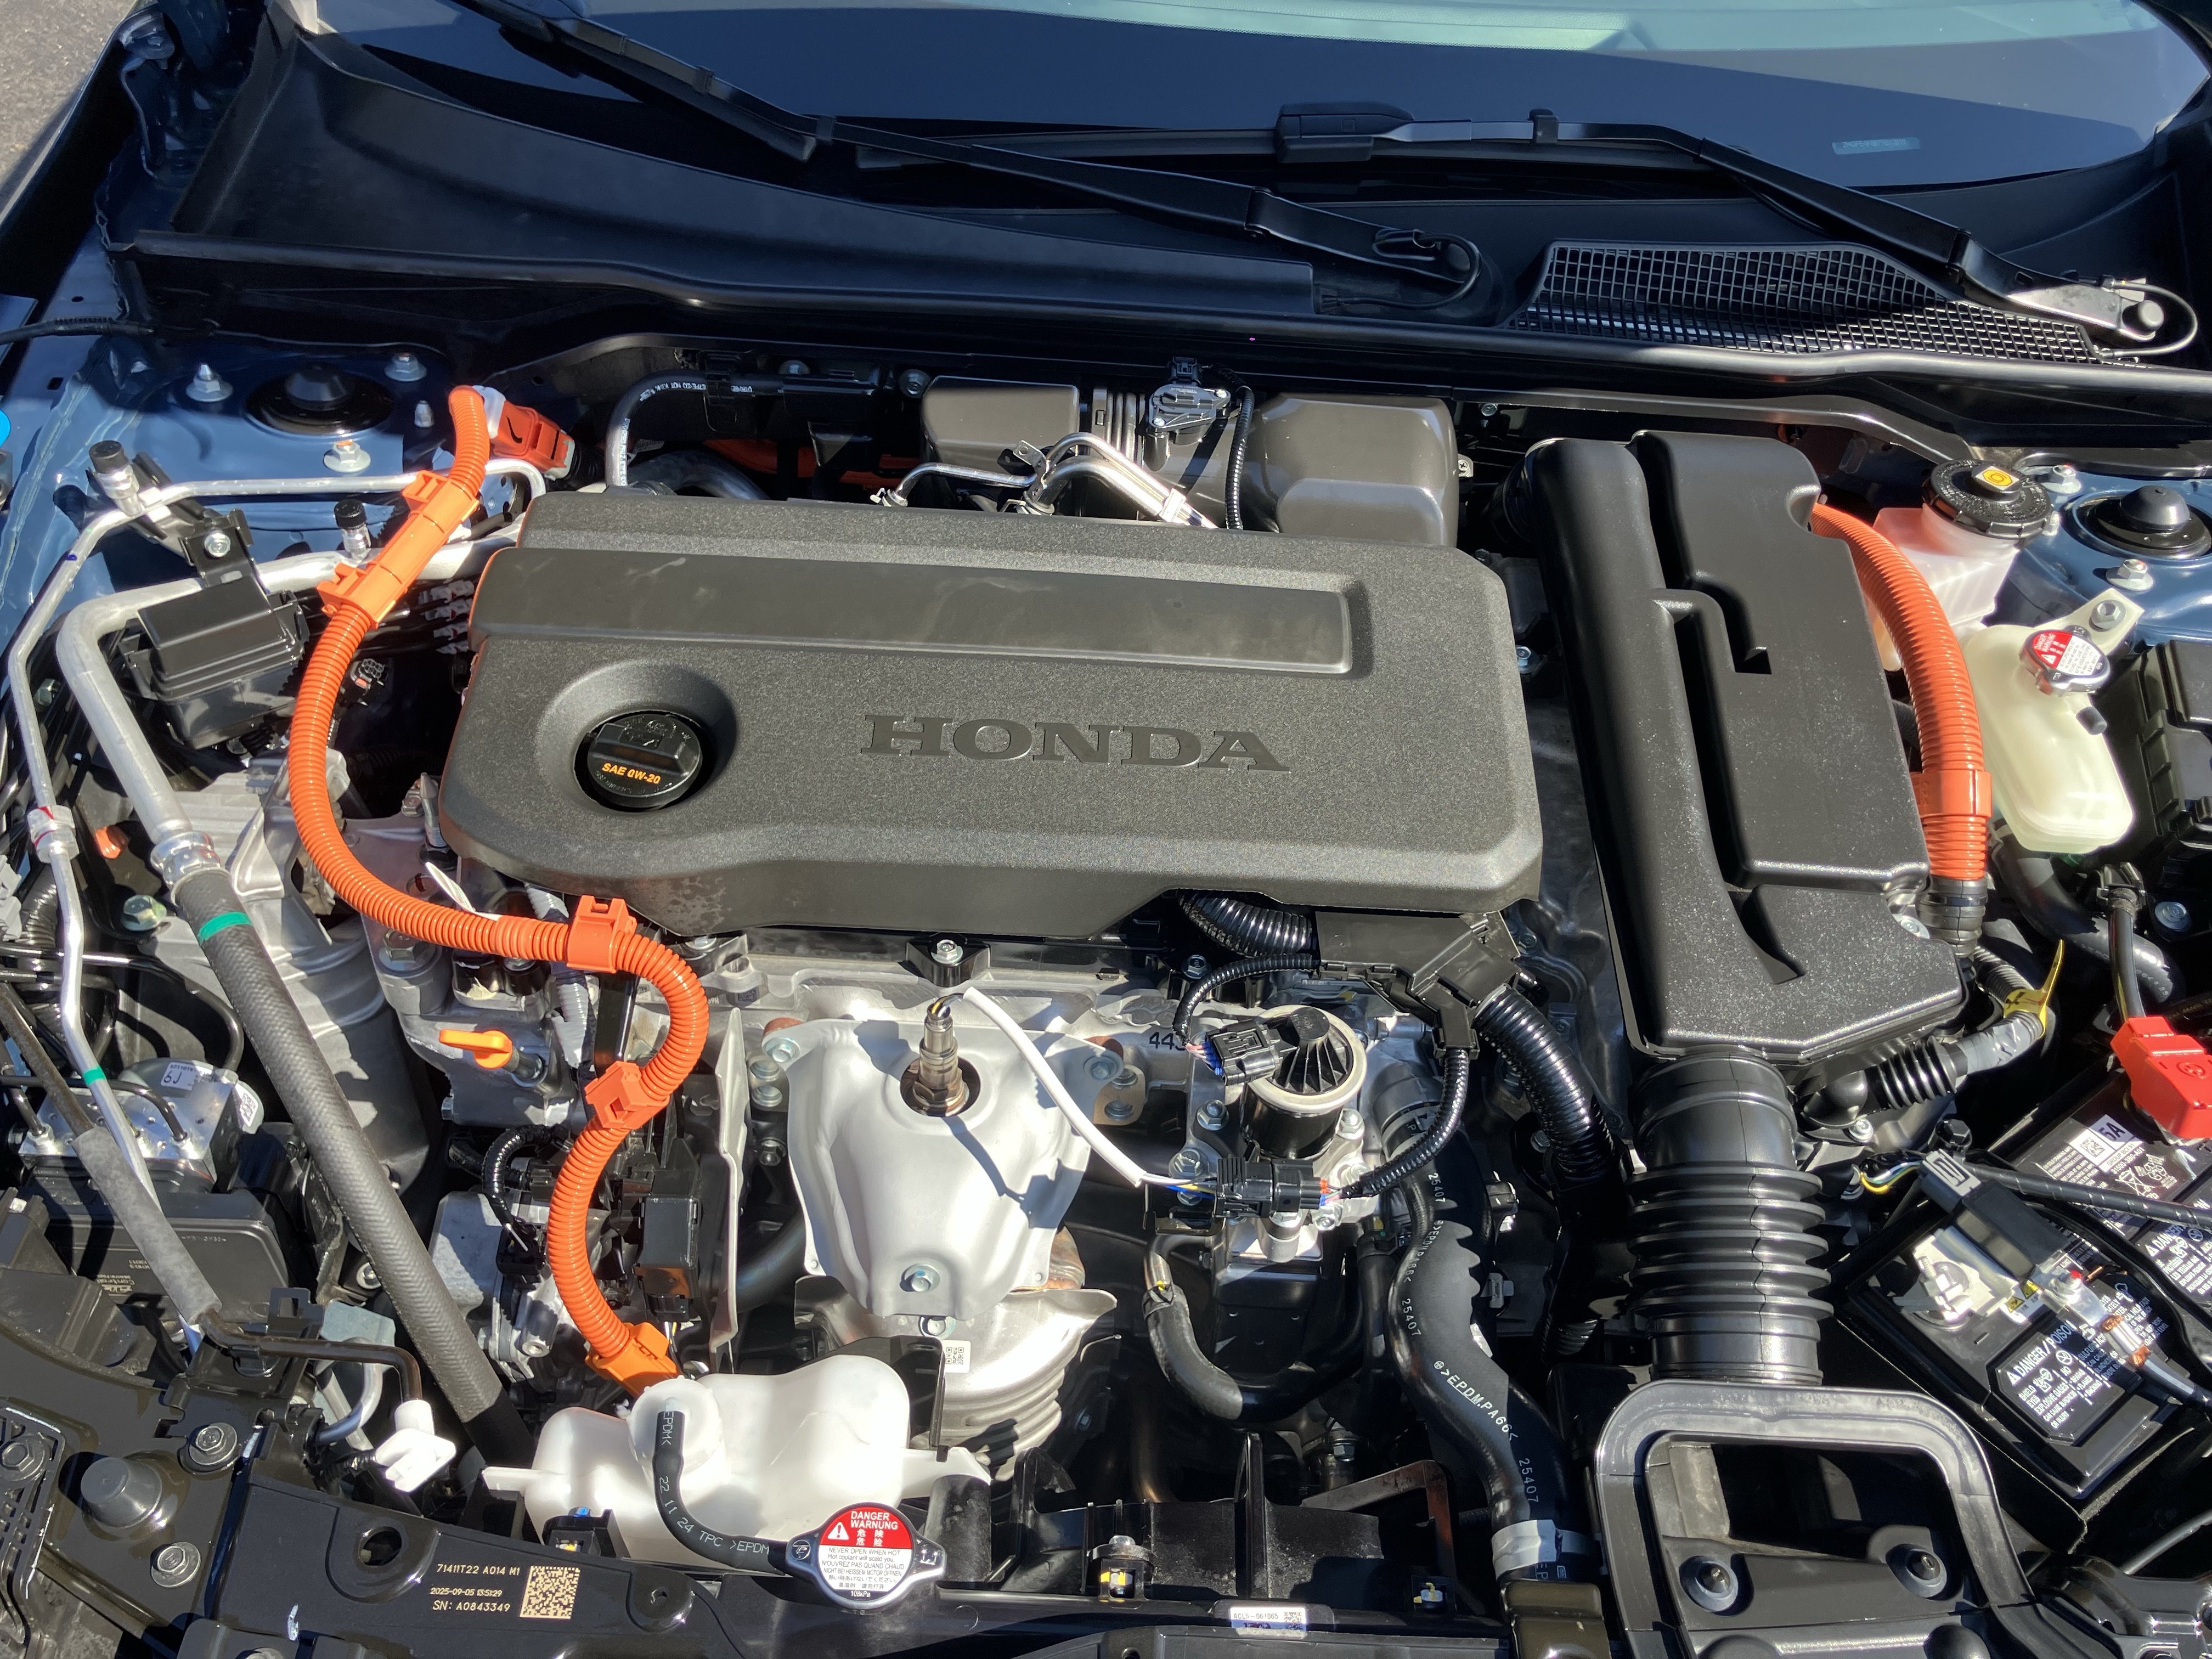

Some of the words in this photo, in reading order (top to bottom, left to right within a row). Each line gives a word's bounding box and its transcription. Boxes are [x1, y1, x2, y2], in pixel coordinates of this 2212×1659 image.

[860, 714, 1291, 773] HONDA
[602, 763, 626, 776] SAE
[627, 769, 662, 785] 0W-20
[2098, 1122, 2126, 1141] 5A
[2107, 1153, 2123, 1166] GROUP
[1428, 1172, 1446, 1203] 25407
[1402, 1299, 1421, 1336] 25407
[2061, 1365, 2071, 1376] NO
[2018, 1384, 2036, 1401] SHIELD
[2026, 1395, 2040, 1408] EYES
[1519, 1458, 1539, 1503] 25407
[659, 1476, 669, 1494] 22
[677, 1517, 695, 1533] 24
[699, 1530, 724, 1547] TPC
[851, 1510, 890, 1521] DANGER
[850, 1520, 898, 1530] WARNUNG
[436, 1564, 479, 1574] 71411T22
[482, 1566, 505, 1575] A014
[509, 1567, 520, 1576] M1
[430, 1587, 475, 1596] 2025-09-05
[432, 1600, 452, 1611] SN:
[456, 1601, 511, 1612] A0843349
